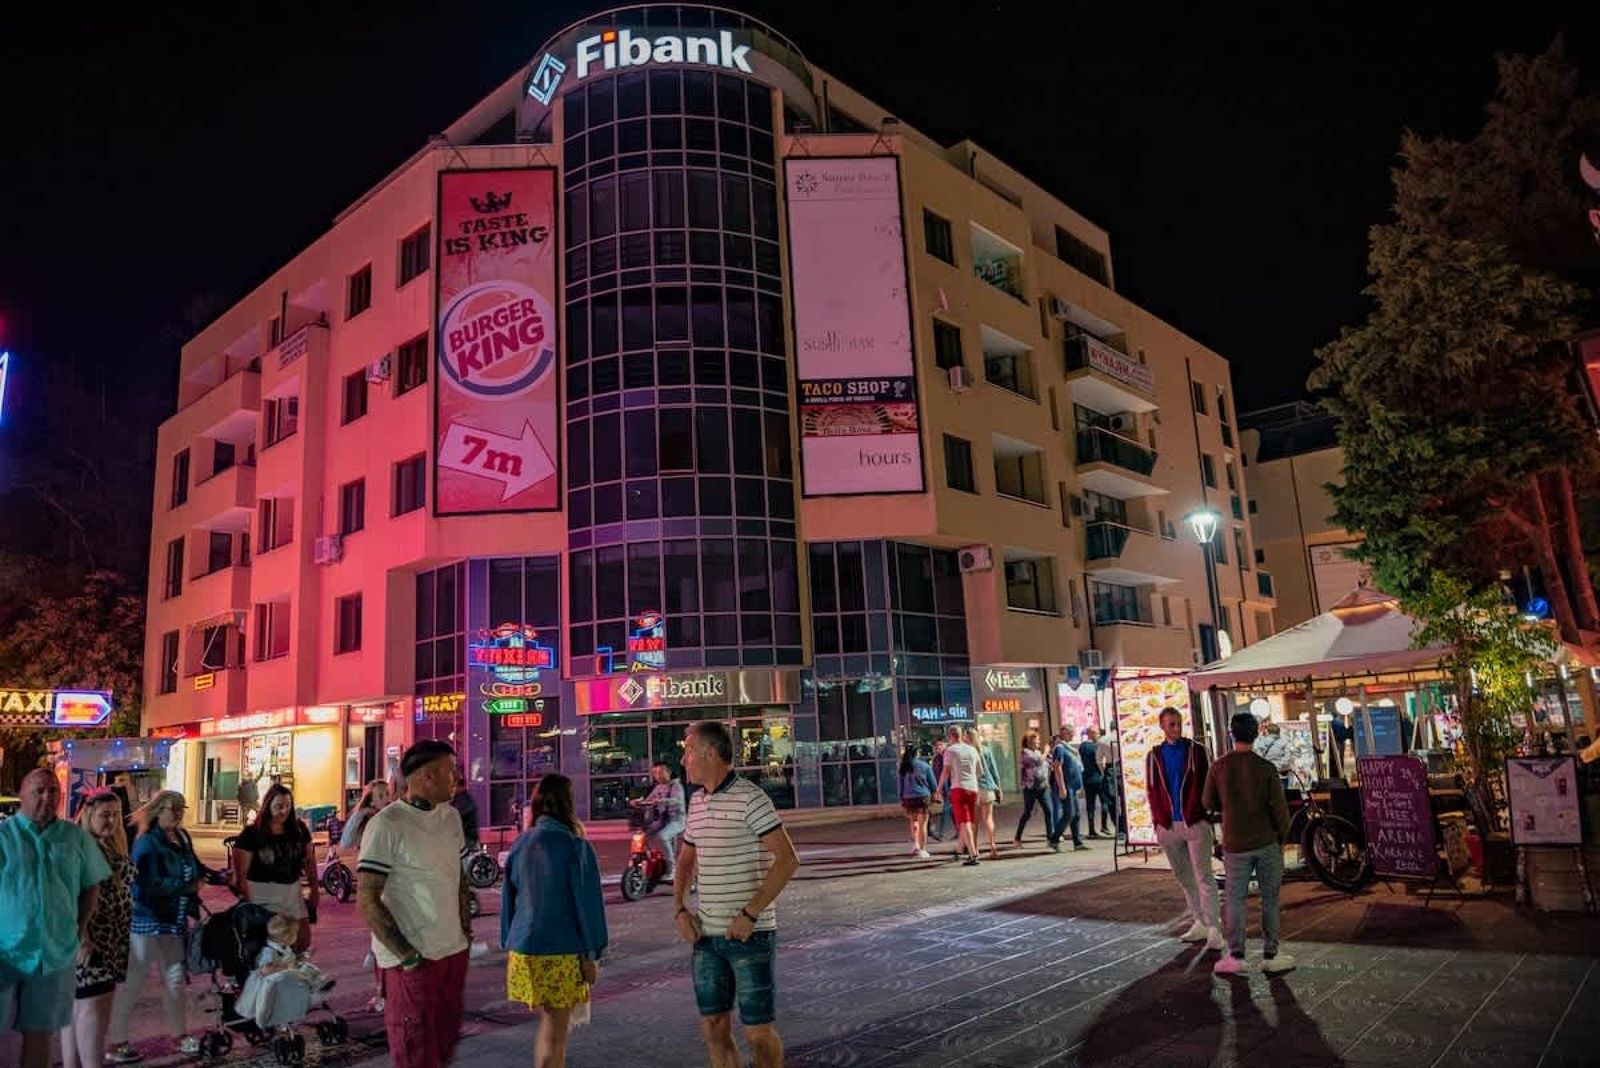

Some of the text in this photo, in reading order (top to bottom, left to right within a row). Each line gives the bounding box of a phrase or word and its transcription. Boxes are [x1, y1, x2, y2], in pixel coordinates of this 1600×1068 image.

[576, 29, 752, 79] Fibank
[459, 213, 529, 235] TASTE
[445, 226, 549, 256] IS KING
[448, 298, 538, 353] BURGER
[456, 316, 545, 379] KING
[802, 381, 891, 396] TACO SHOP
[460, 435, 523, 477] 7m
[858, 448, 912, 466] hours
[646, 674, 724, 700] Fibank
[1360, 760, 1394, 775] HAPPY
